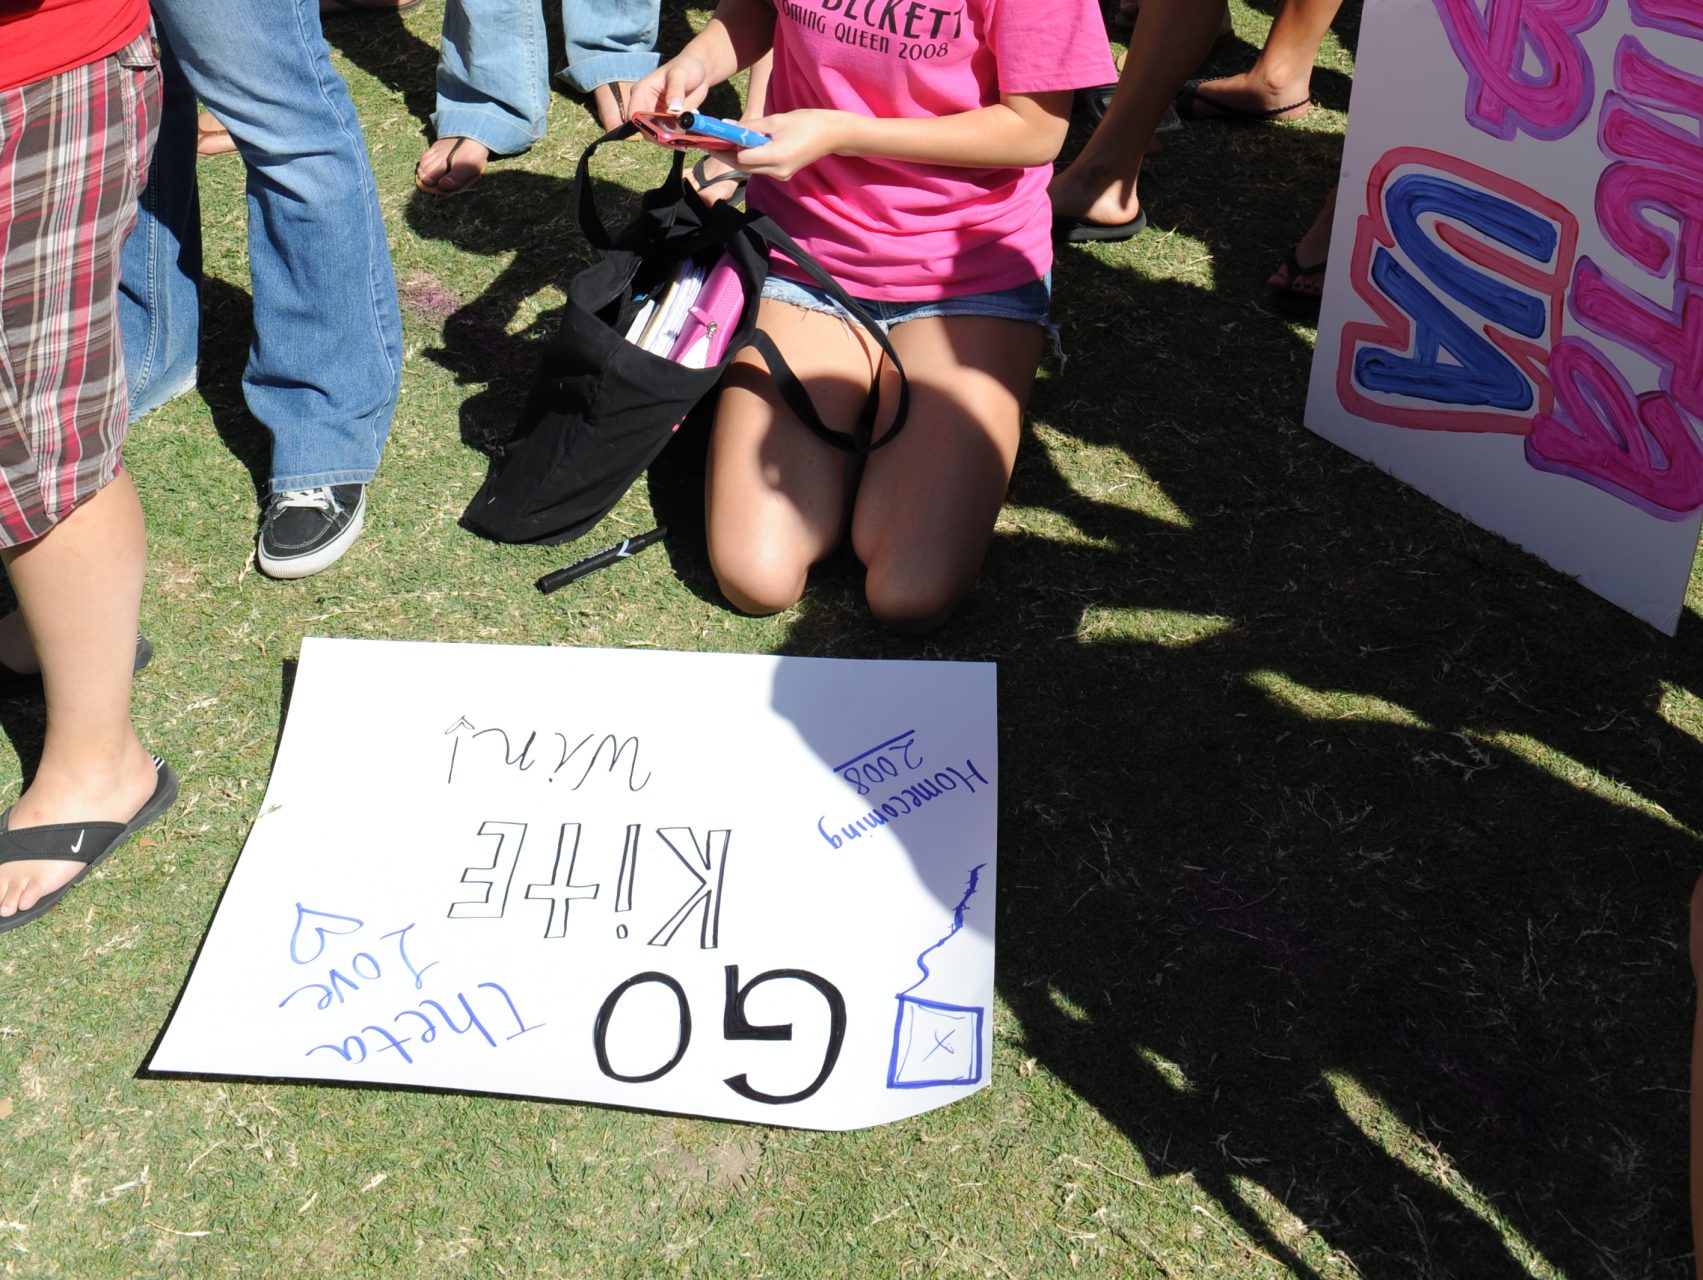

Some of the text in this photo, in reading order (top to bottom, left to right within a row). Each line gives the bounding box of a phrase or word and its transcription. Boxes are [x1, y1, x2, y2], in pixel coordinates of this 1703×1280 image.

[834, 23, 890, 55] QUEEN
[898, 42, 949, 62] 2008
[1348, 163, 1564, 422] UA
[817, 758, 989, 850] Homecoming
[843, 738, 924, 796] 2008
[278, 922, 440, 1011] Love
[305, 982, 547, 1065] Theta
[592, 963, 848, 1106] GO
